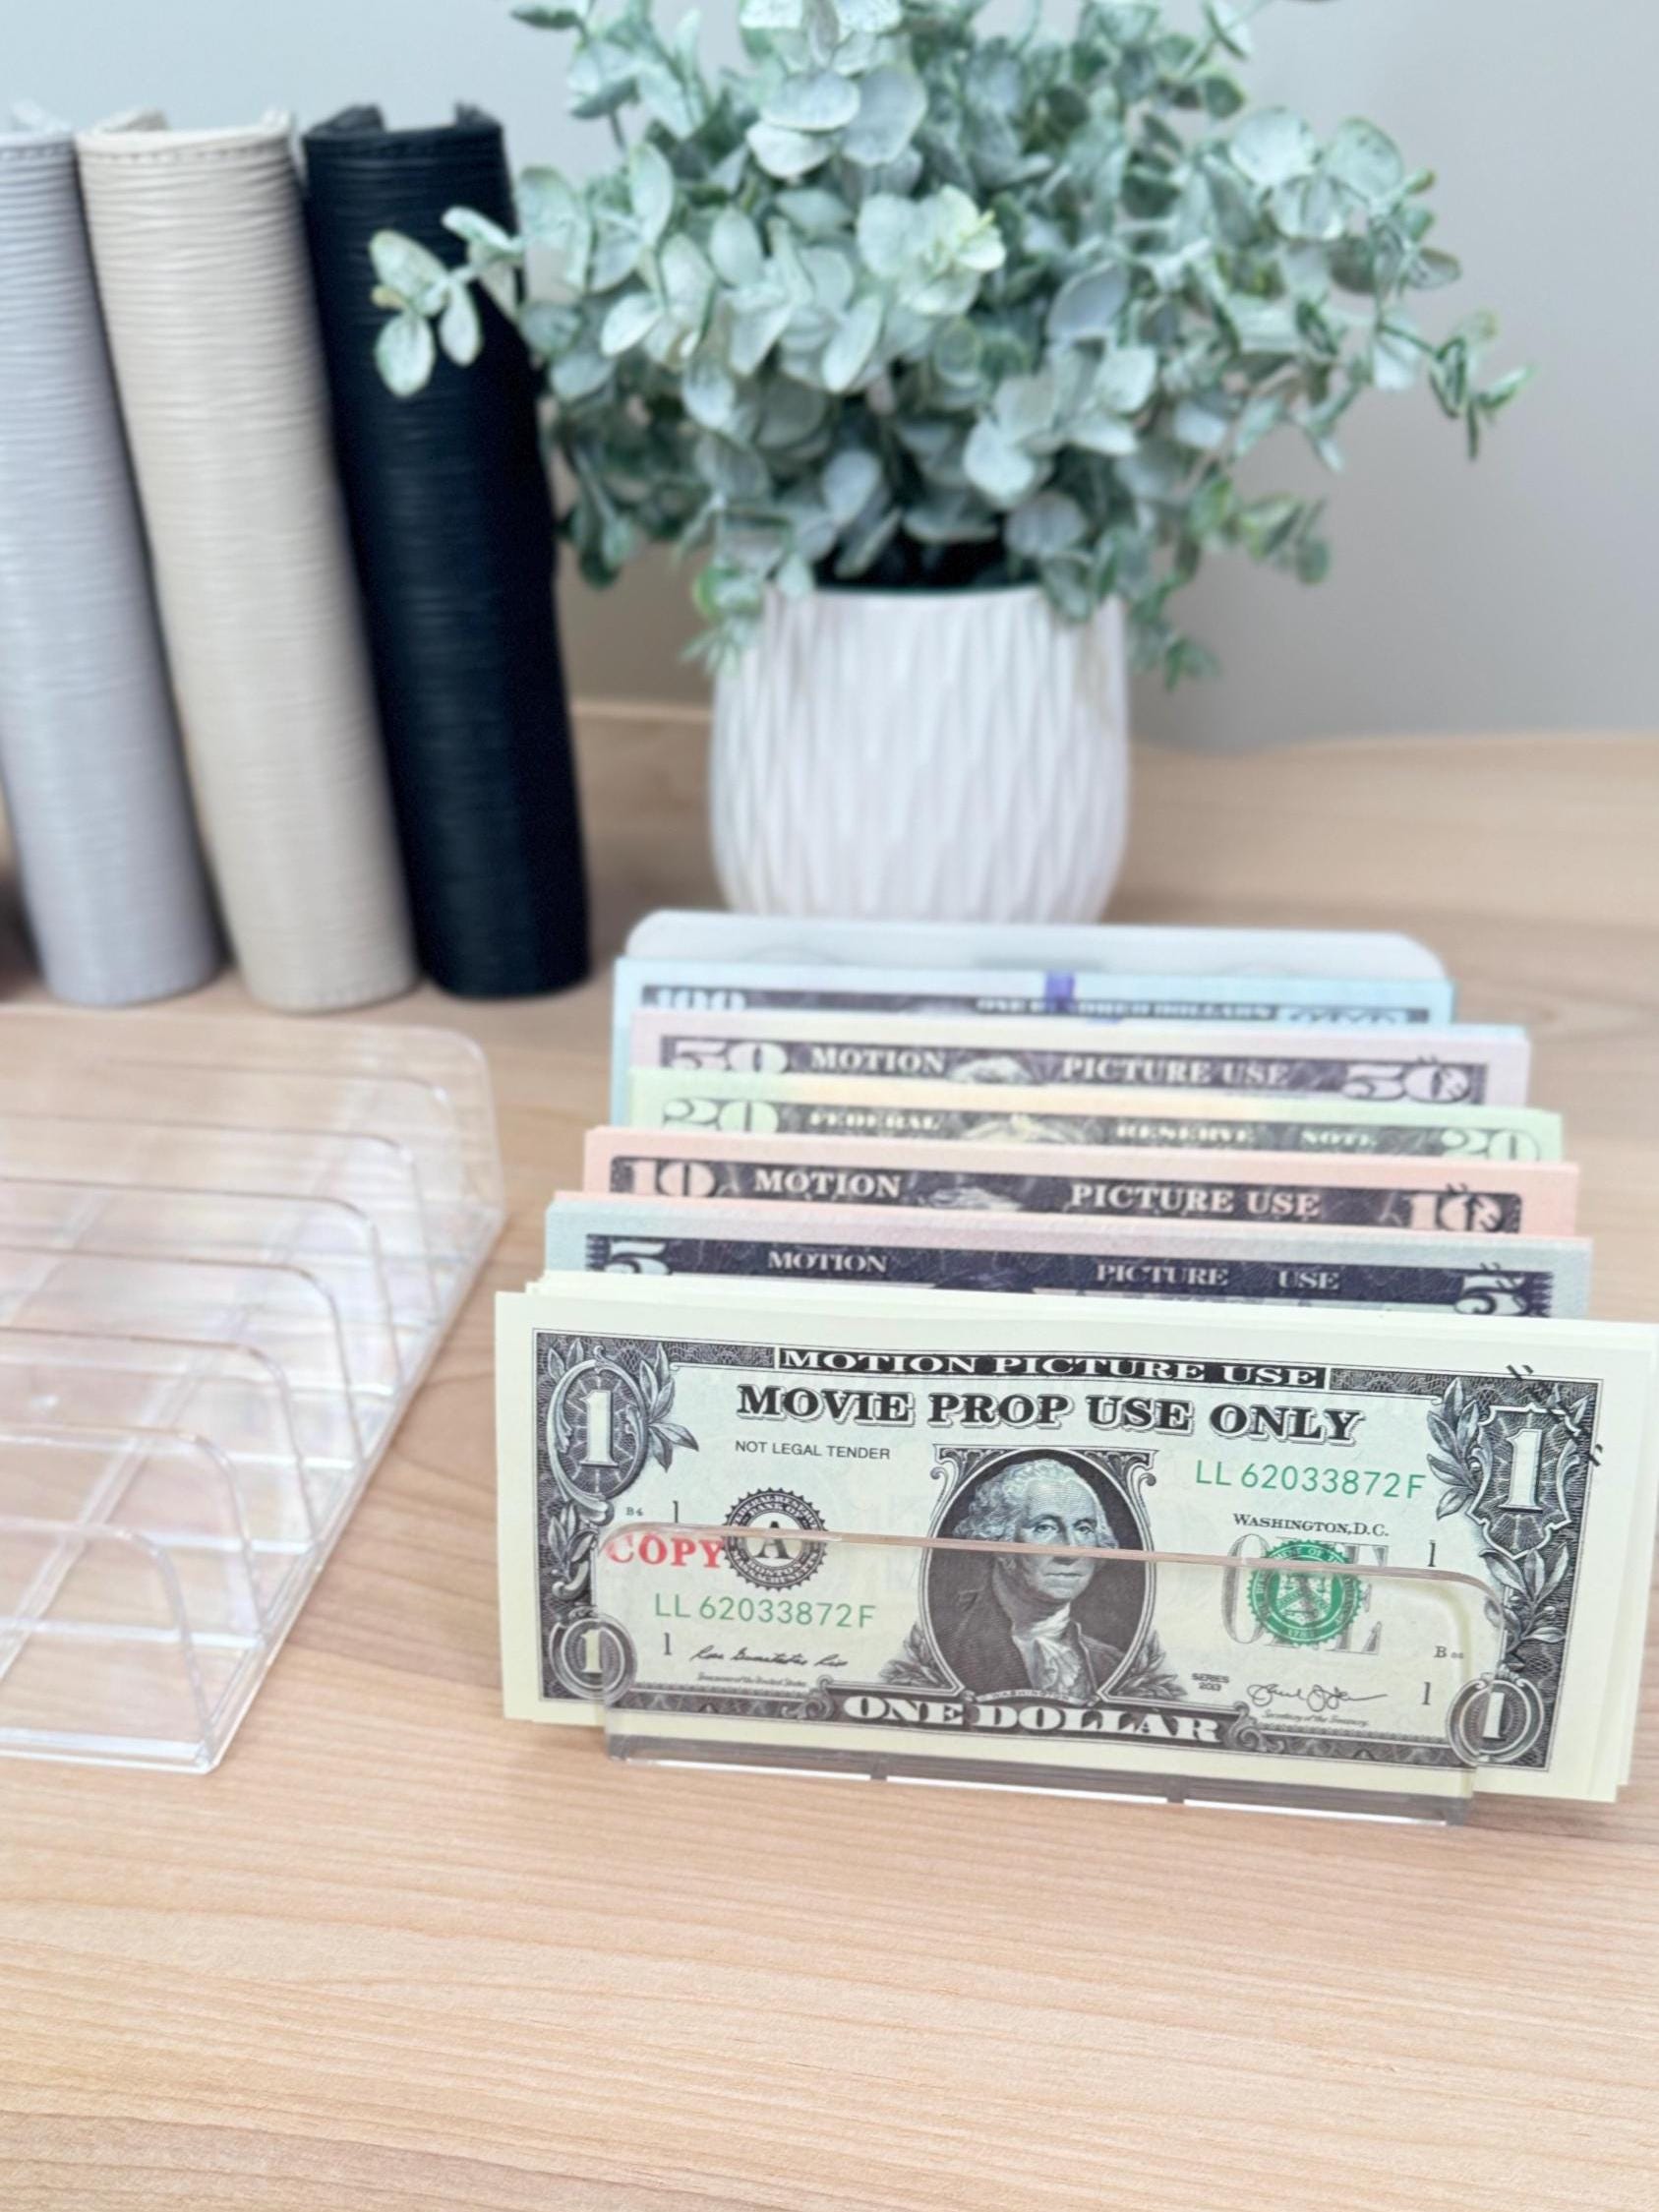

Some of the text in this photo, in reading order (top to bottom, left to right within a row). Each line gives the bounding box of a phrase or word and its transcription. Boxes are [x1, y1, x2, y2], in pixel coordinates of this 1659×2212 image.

[810, 1046, 945, 1074] MOTION
[1062, 1056, 1211, 1085] PICTURE
[1222, 1061, 1290, 1087] USE
[1339, 1060, 1472, 1104] 50
[809, 1109, 940, 1131] FEDERAL
[1116, 1123, 1255, 1144] RESERVE
[1300, 1130, 1377, 1149] NOTE
[753, 1168, 902, 1199] MOTION
[1071, 1182, 1234, 1213] PICTURE
[1246, 1187, 1322, 1218] USE
[767, 1250, 888, 1274] MOTION
[1096, 1263, 1228, 1287] PICTURE
[1278, 1270, 1340, 1291] USE
[783, 1348, 1319, 1387] MOTION PICTURE USE
[580, 1389, 619, 1468] 1
[736, 1383, 1366, 1447] MOVIE PROP USE ONLY
[735, 1440, 891, 1461] NOT LEGAL TENDER
[1497, 1427, 1544, 1515] 1
[606, 1531, 726, 1569] COPY
[750, 1521, 796, 1559] A
[1191, 1672, 1230, 1684] SERIES
[843, 1695, 1220, 1743] ONE DOLLAR
